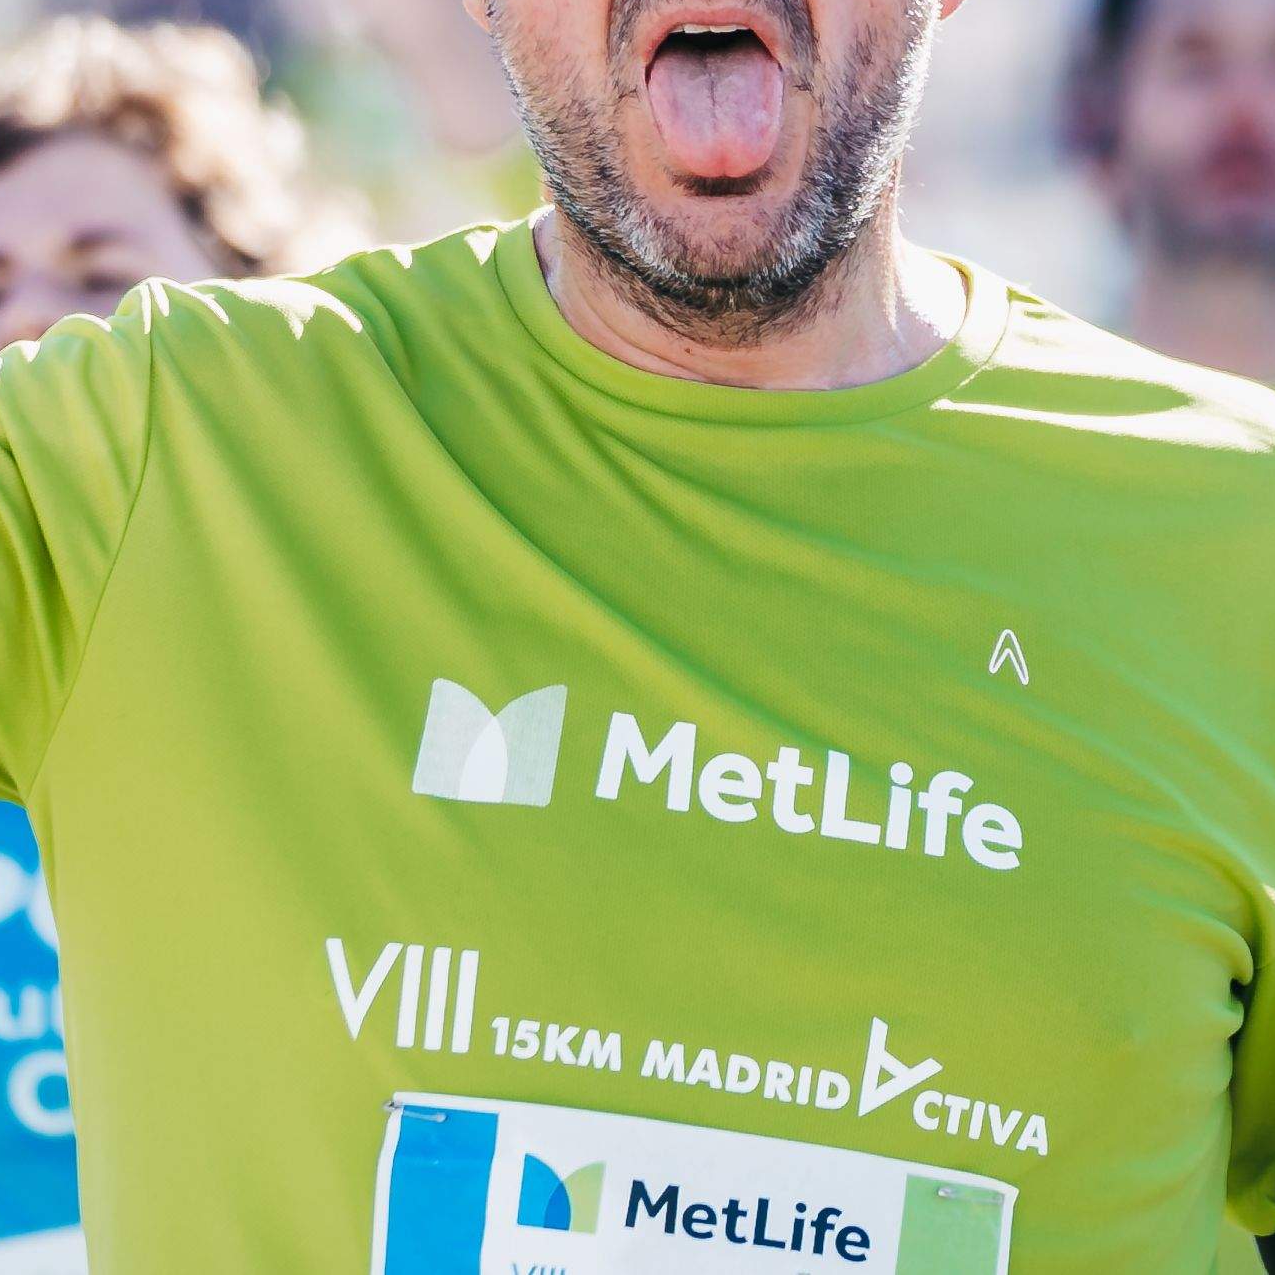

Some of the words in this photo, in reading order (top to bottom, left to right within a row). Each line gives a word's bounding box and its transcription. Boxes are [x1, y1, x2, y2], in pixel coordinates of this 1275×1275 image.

[595, 711, 1024, 871] MetLife
[325, 937, 480, 1054] VIII
[491, 1016, 623, 1072] 15KM
[639, 1039, 852, 1111] MADRID
[625, 1179, 871, 1263] MetLife
